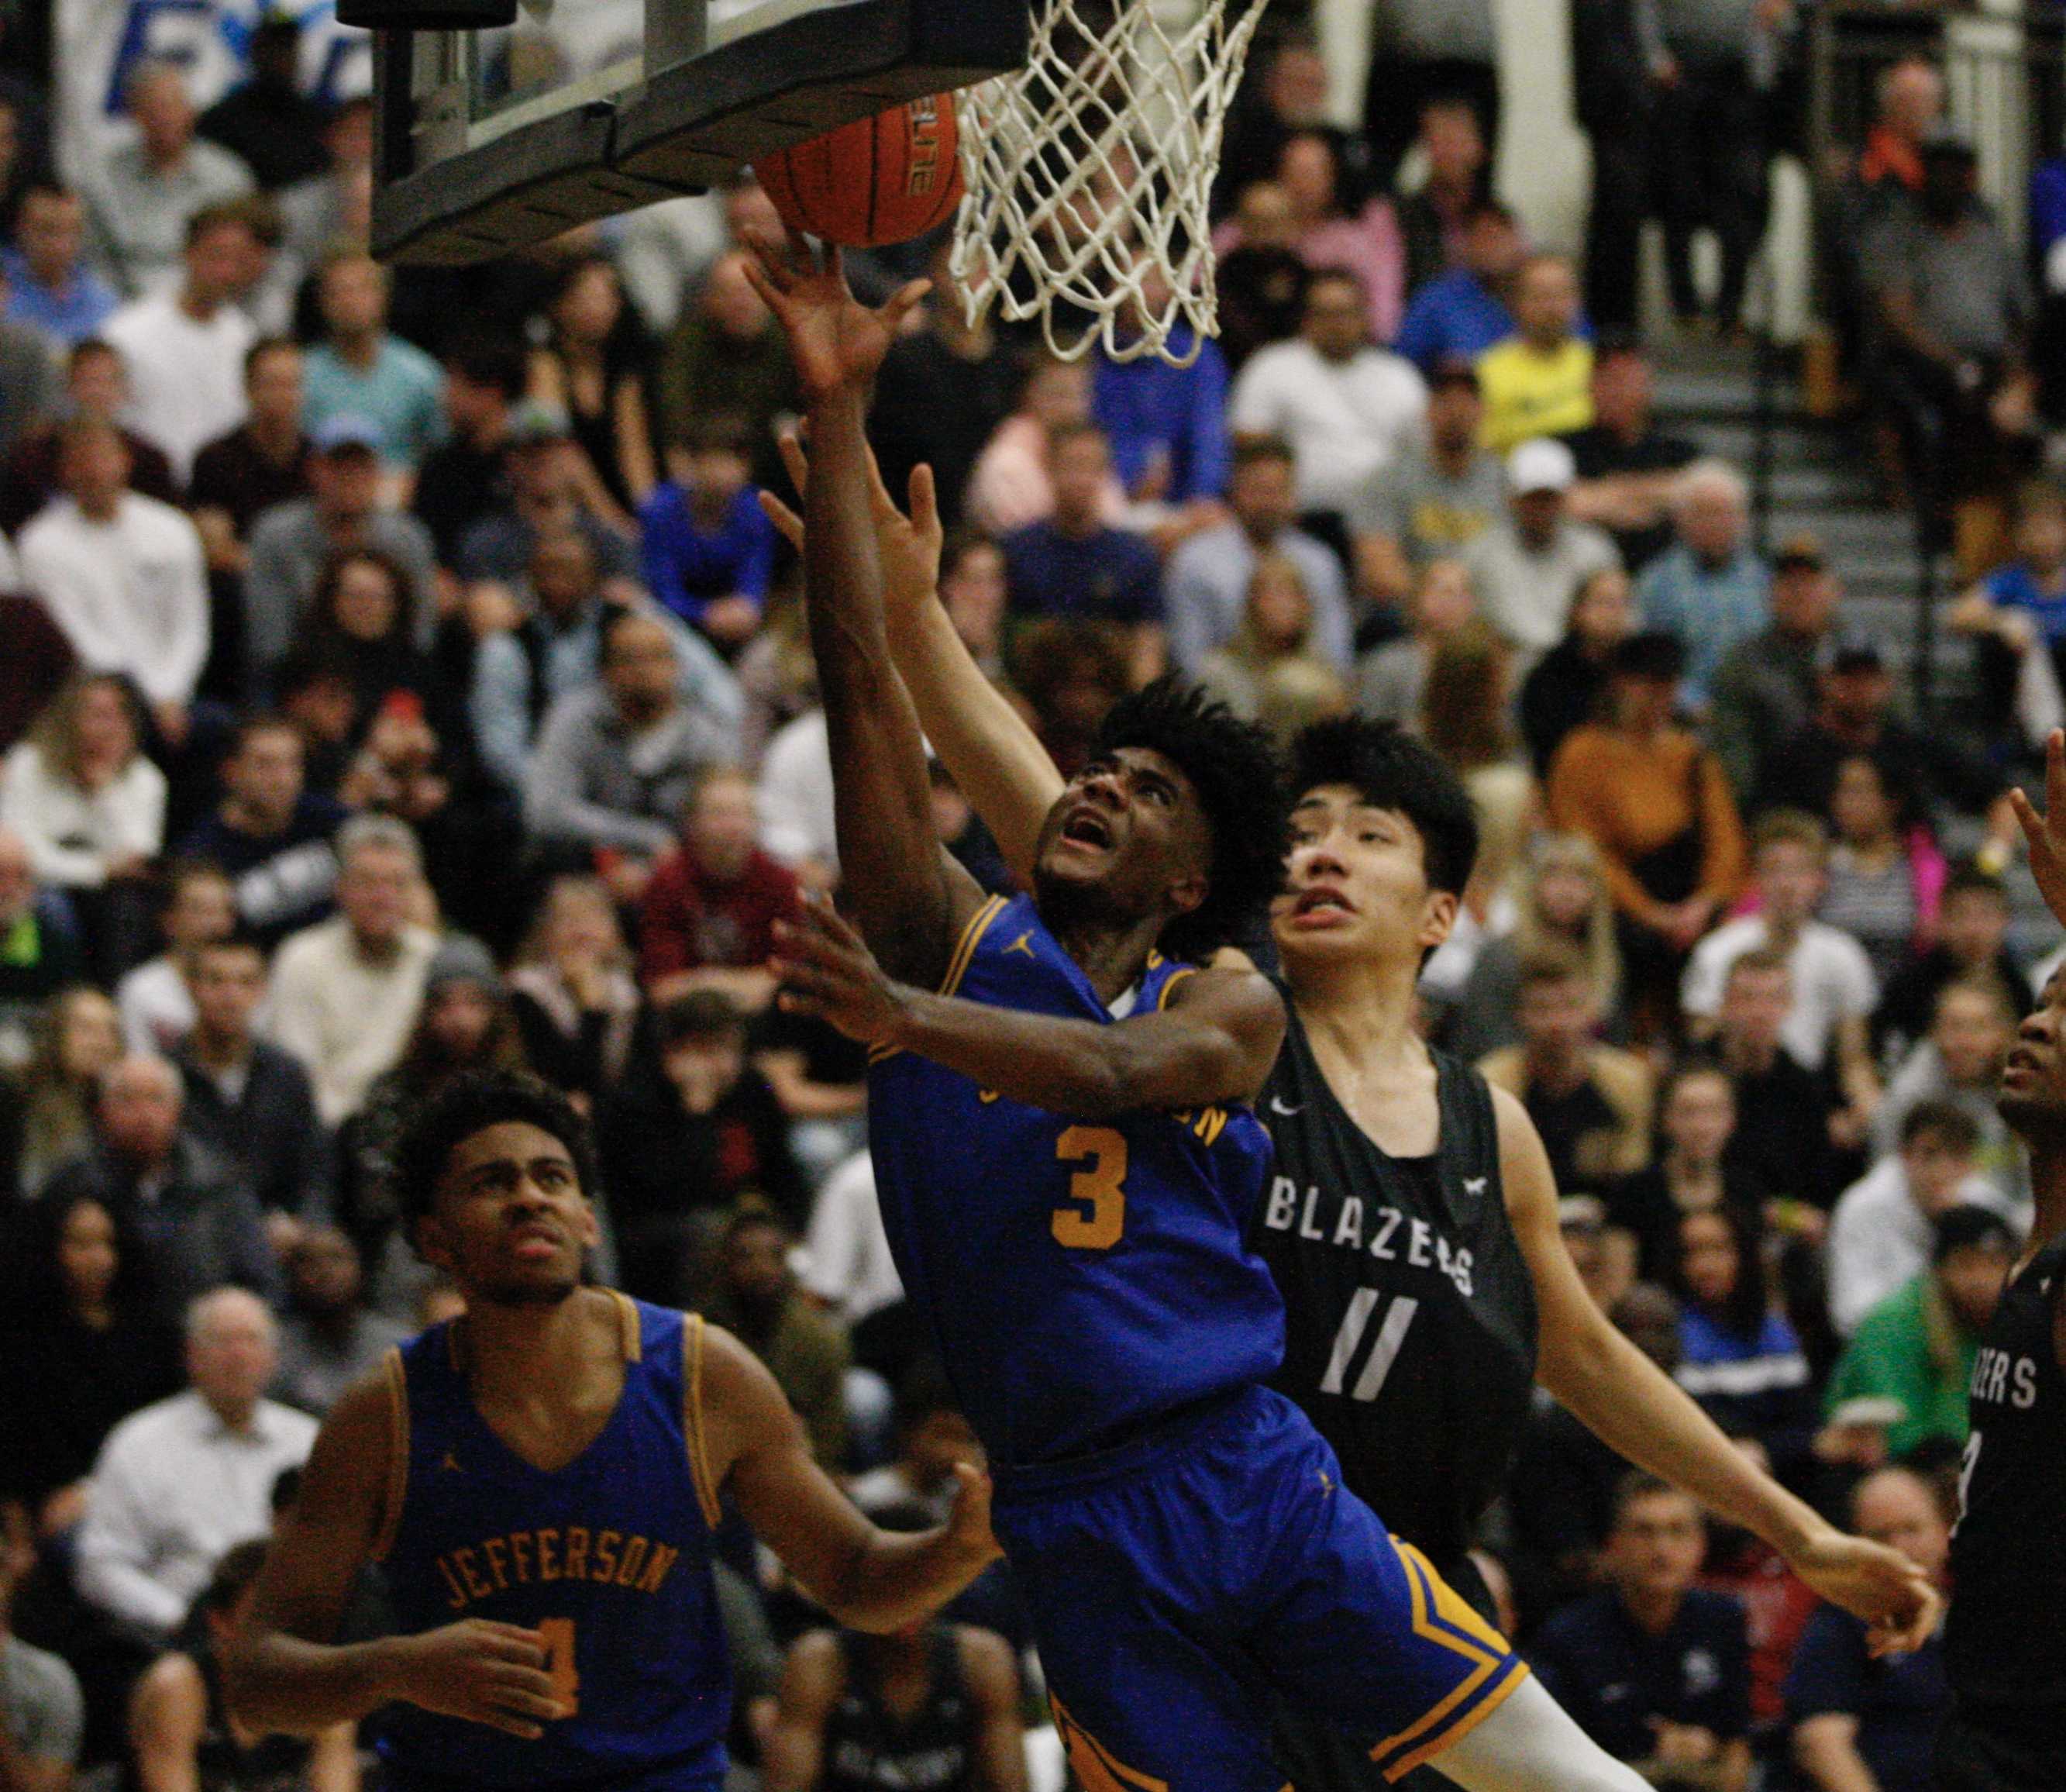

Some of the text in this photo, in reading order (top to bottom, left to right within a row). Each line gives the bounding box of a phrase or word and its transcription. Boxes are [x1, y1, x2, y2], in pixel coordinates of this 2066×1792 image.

[1051, 1124, 1128, 1250] 3
[1319, 1287, 1419, 1401] 11
[436, 1525, 678, 1609] JEFFERSON
